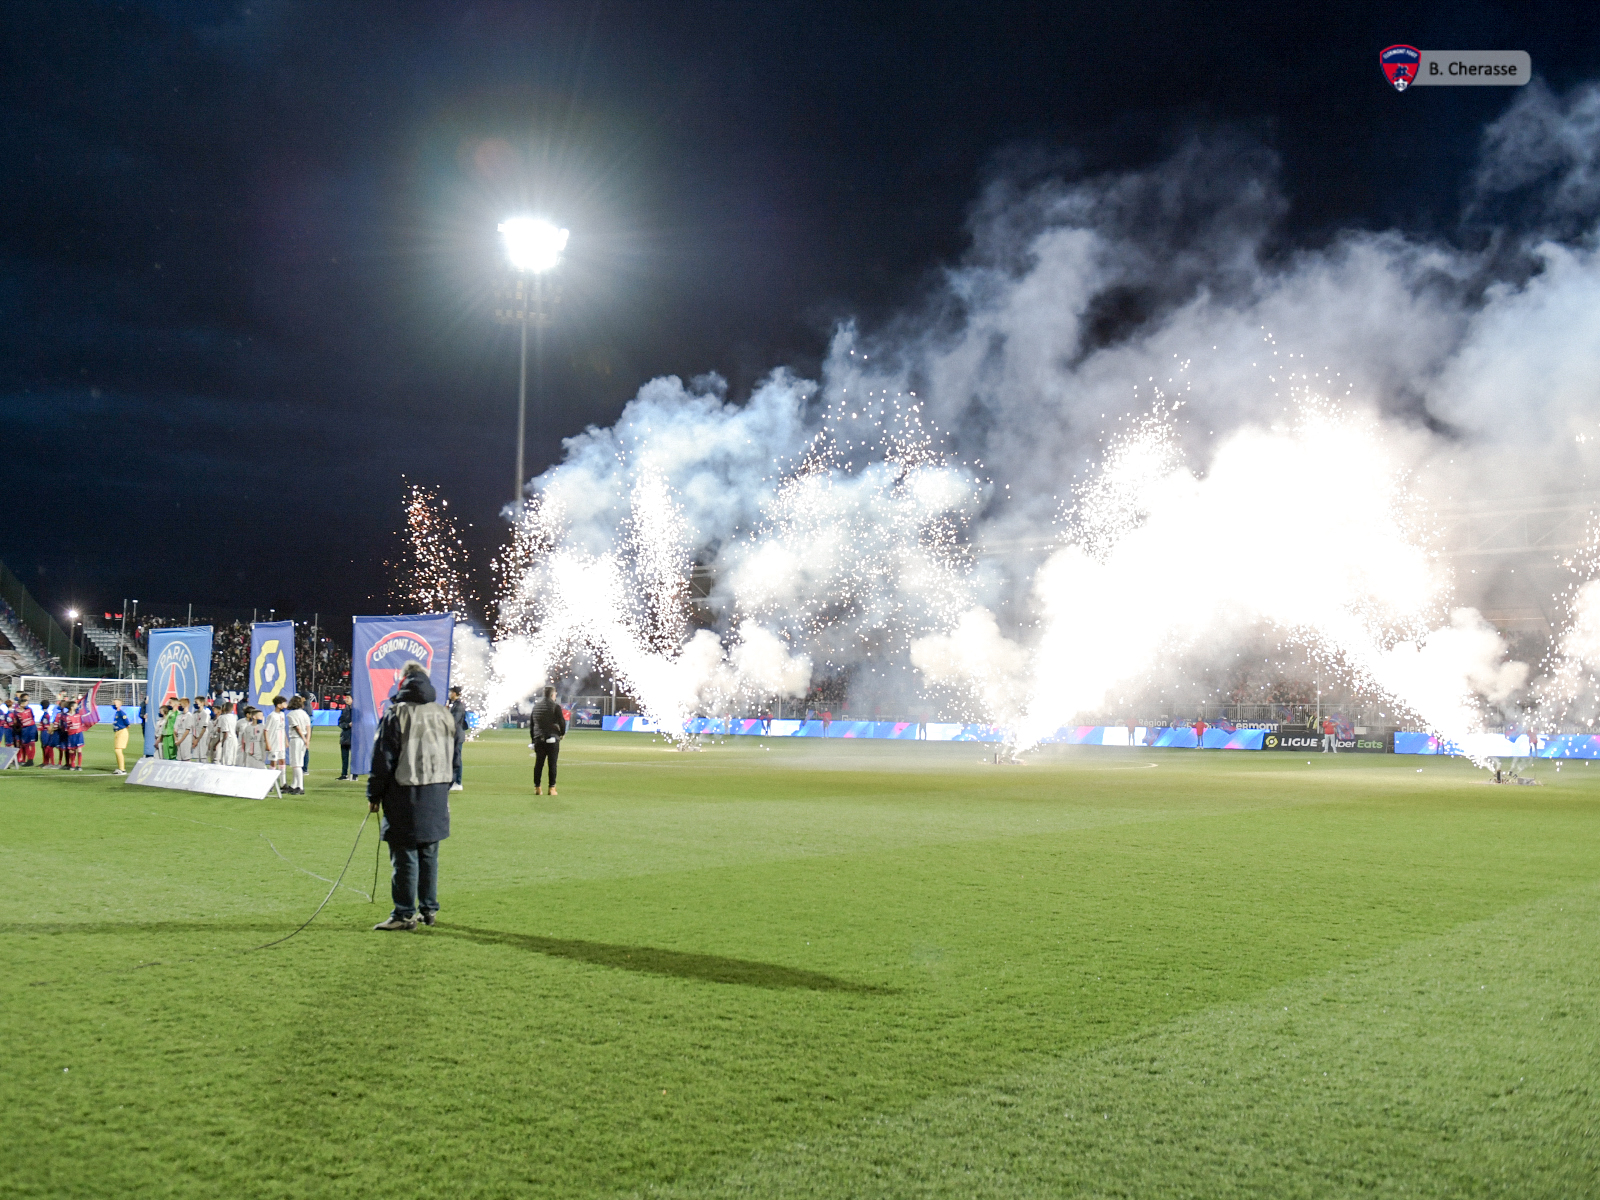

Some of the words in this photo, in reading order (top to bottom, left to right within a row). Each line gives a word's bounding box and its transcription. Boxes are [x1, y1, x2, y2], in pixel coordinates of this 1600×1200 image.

[160, 645, 190, 670] PARIS
[373, 638, 409, 662] CLERMONT
[407, 640, 428, 661] FOOT
[1138, 718, 1168, 728] Région
[1280, 738, 1318, 747] LIGUE
[1356, 739, 1383, 749] Eats
[153, 764, 195, 785] LIGUE
